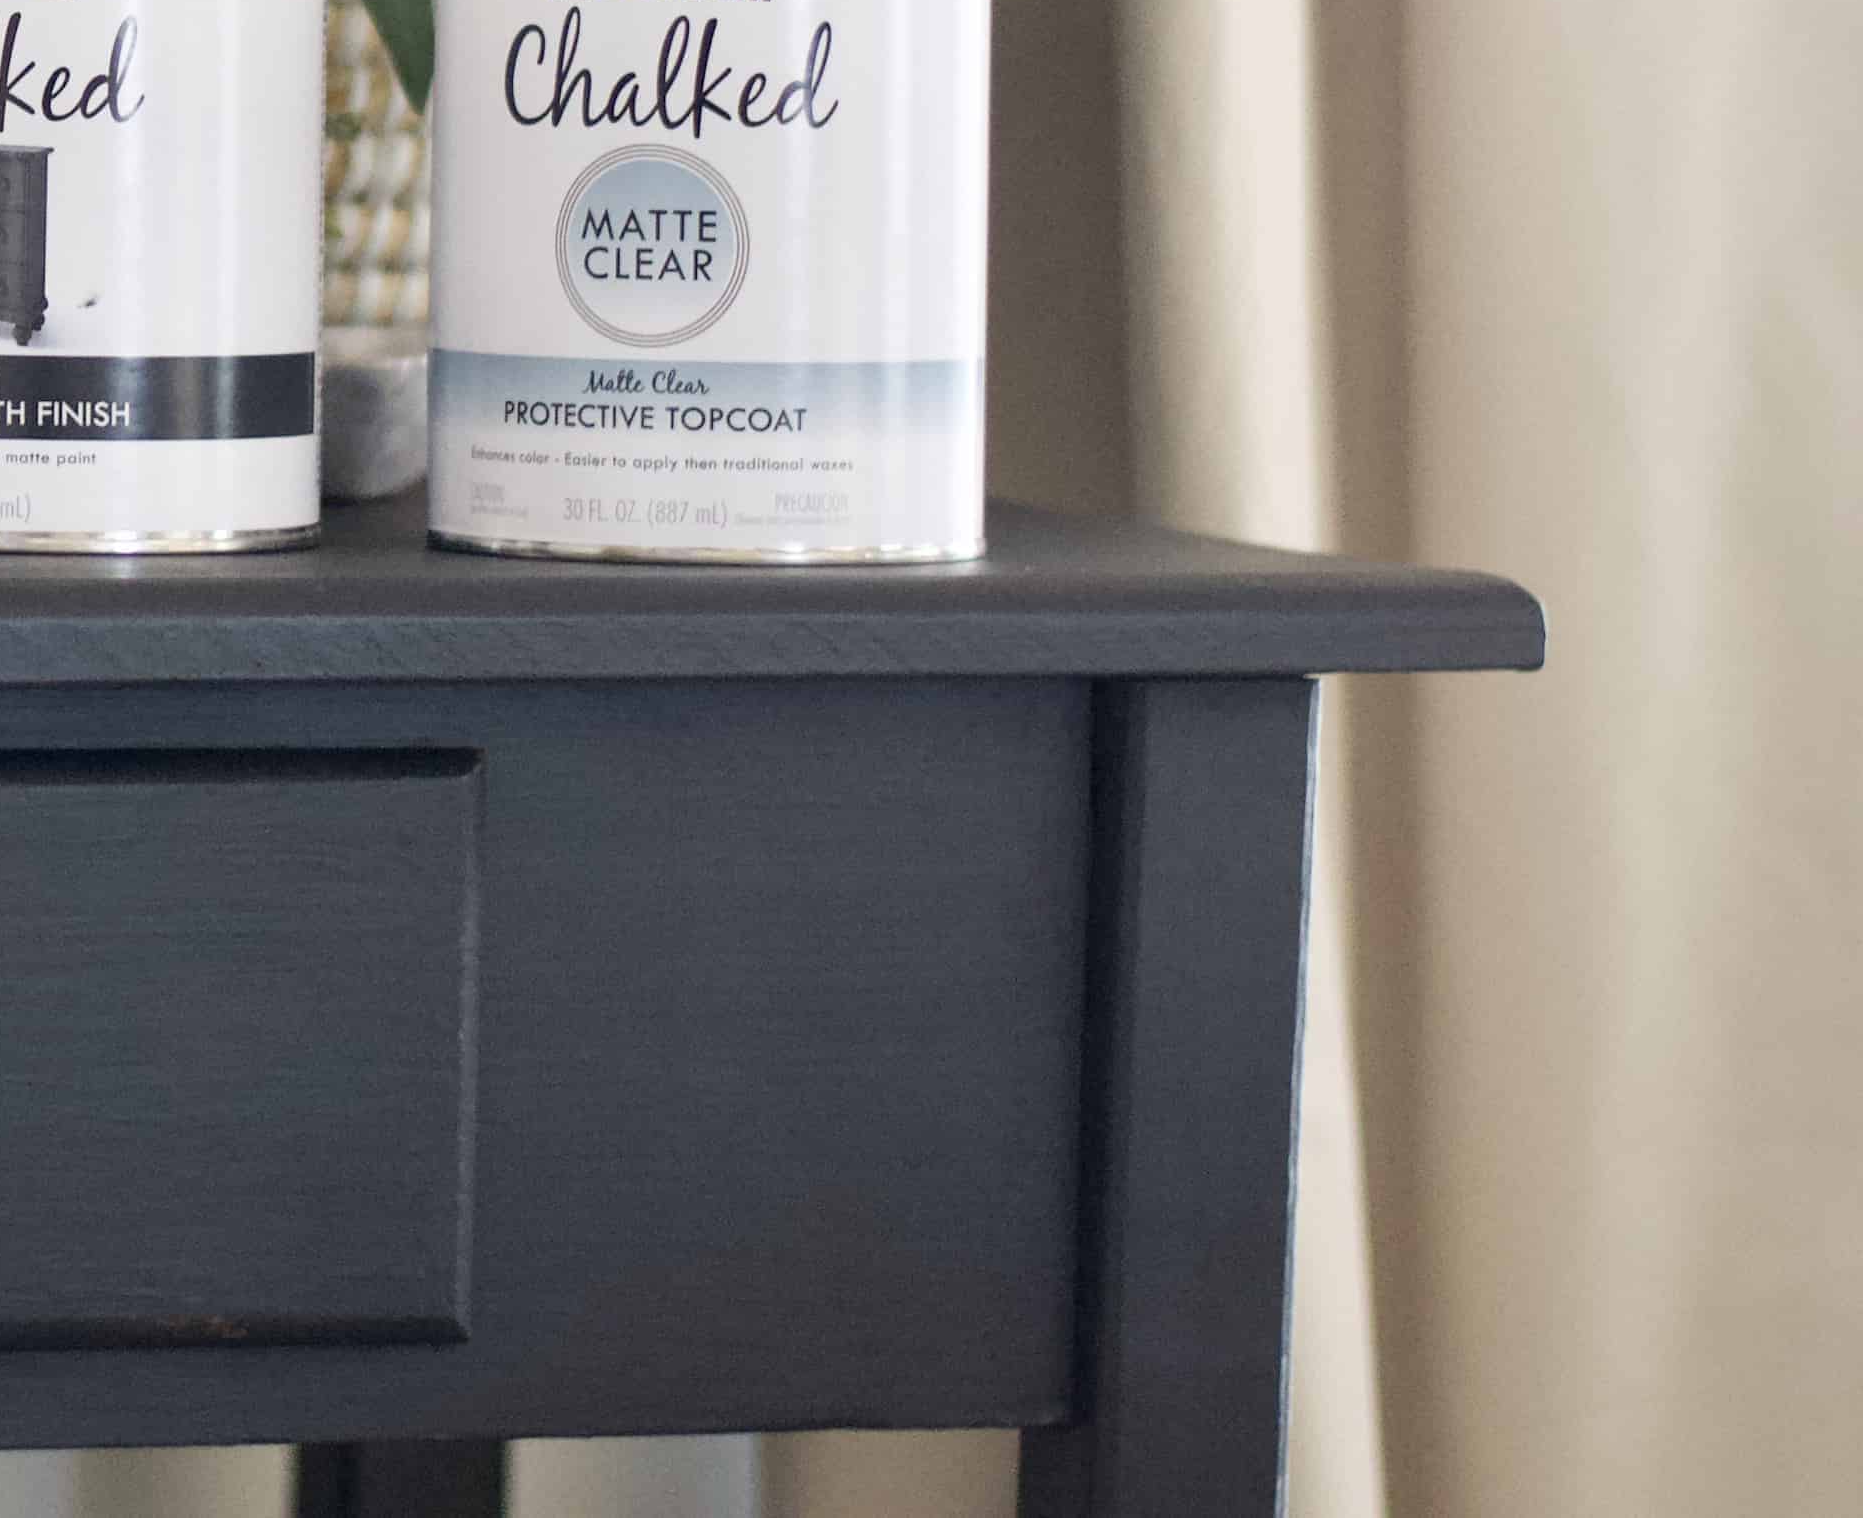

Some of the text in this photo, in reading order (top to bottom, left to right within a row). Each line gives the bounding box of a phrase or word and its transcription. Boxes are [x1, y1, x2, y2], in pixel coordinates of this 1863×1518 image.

[505, 6, 838, 138] Chalked
[581, 208, 717, 242] MATTE
[584, 246, 712, 281] CLEAR
[582, 369, 711, 395] Matte Clear
[37, 400, 131, 427] FINISH
[503, 400, 808, 433] PROTECTIVE TOPCOAT
[5, 451, 50, 465] matte
[56, 450, 97, 467] paint
[519, 449, 550, 465] color
[564, 452, 608, 467] Easier
[612, 456, 627, 469] to
[632, 454, 678, 473] apply
[723, 457, 805, 472] traditional
[809, 460, 855, 473] waxes
[0, 492, 32, 523] mL)
[562, 497, 584, 522] 30
